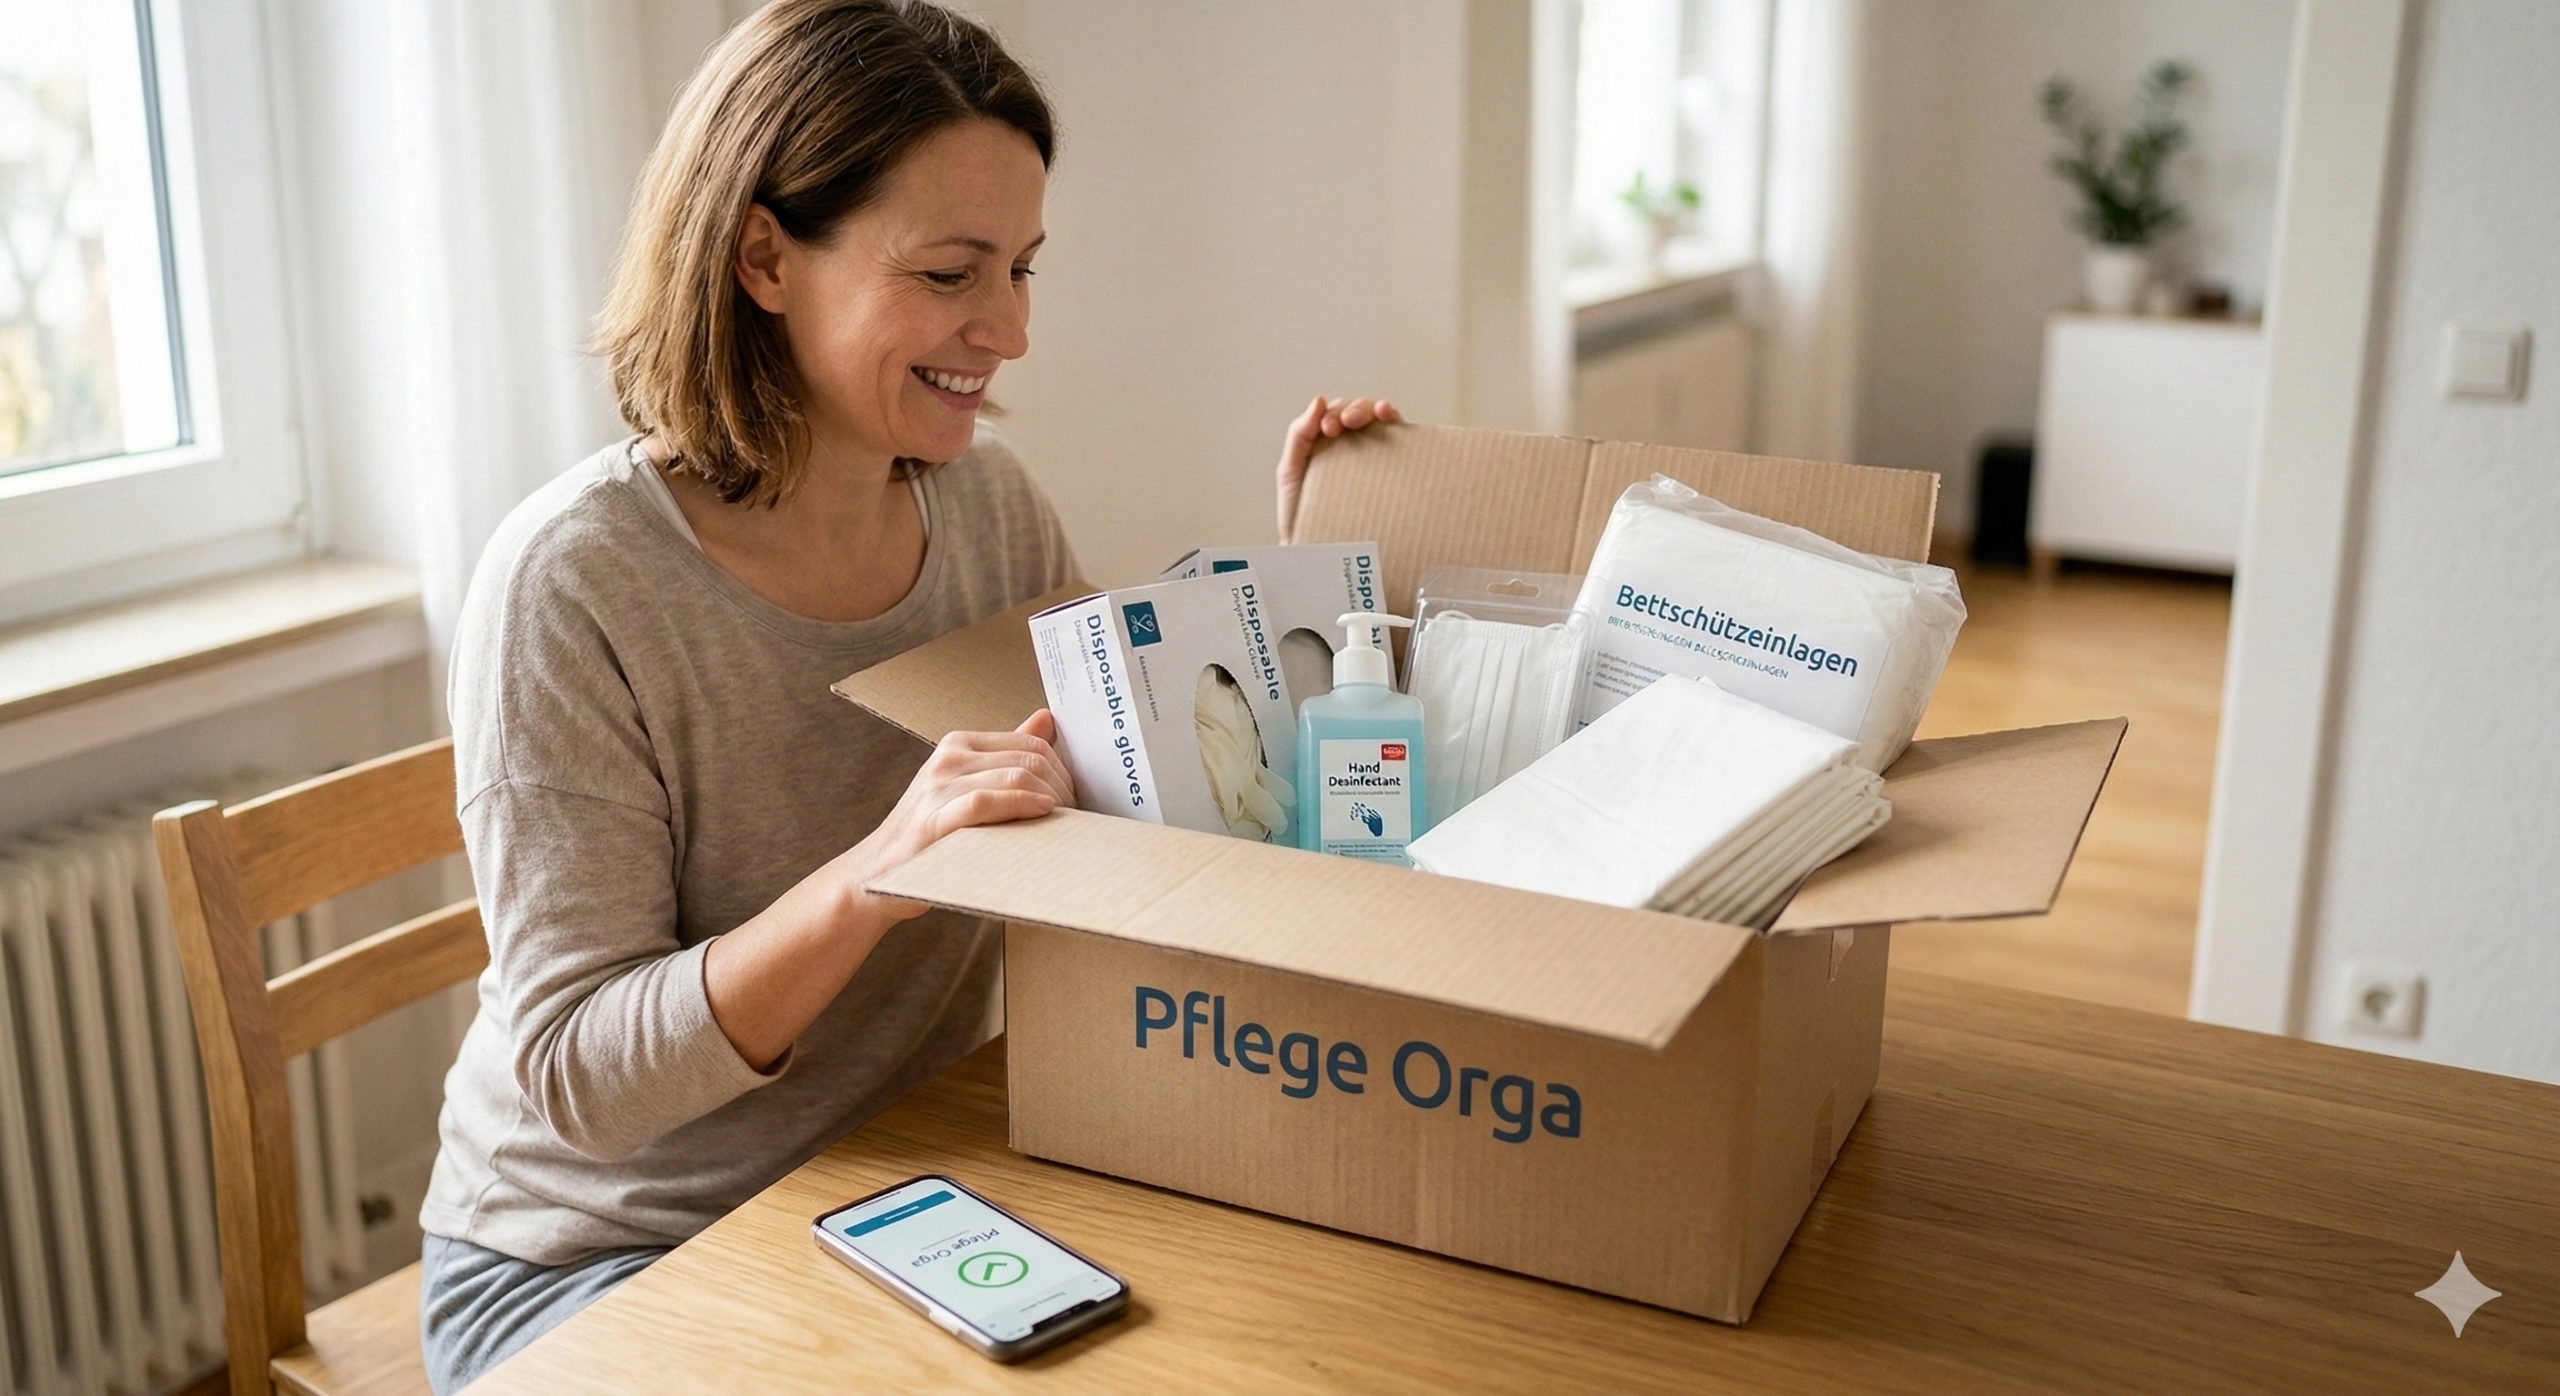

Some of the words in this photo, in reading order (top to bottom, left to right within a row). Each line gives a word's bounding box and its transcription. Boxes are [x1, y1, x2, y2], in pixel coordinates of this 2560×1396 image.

[1240, 583, 1280, 701] Disposable
[1356, 555, 1382, 650] Dispobl
[1616, 584, 1859, 678] Bettschützeinlagen
[1086, 613, 1126, 731] Disposable
[1114, 735, 1145, 807] gloves
[1348, 761, 1381, 774] Hand
[1134, 985, 1369, 1100] Pflege
[1391, 1040, 1583, 1145] Orga
